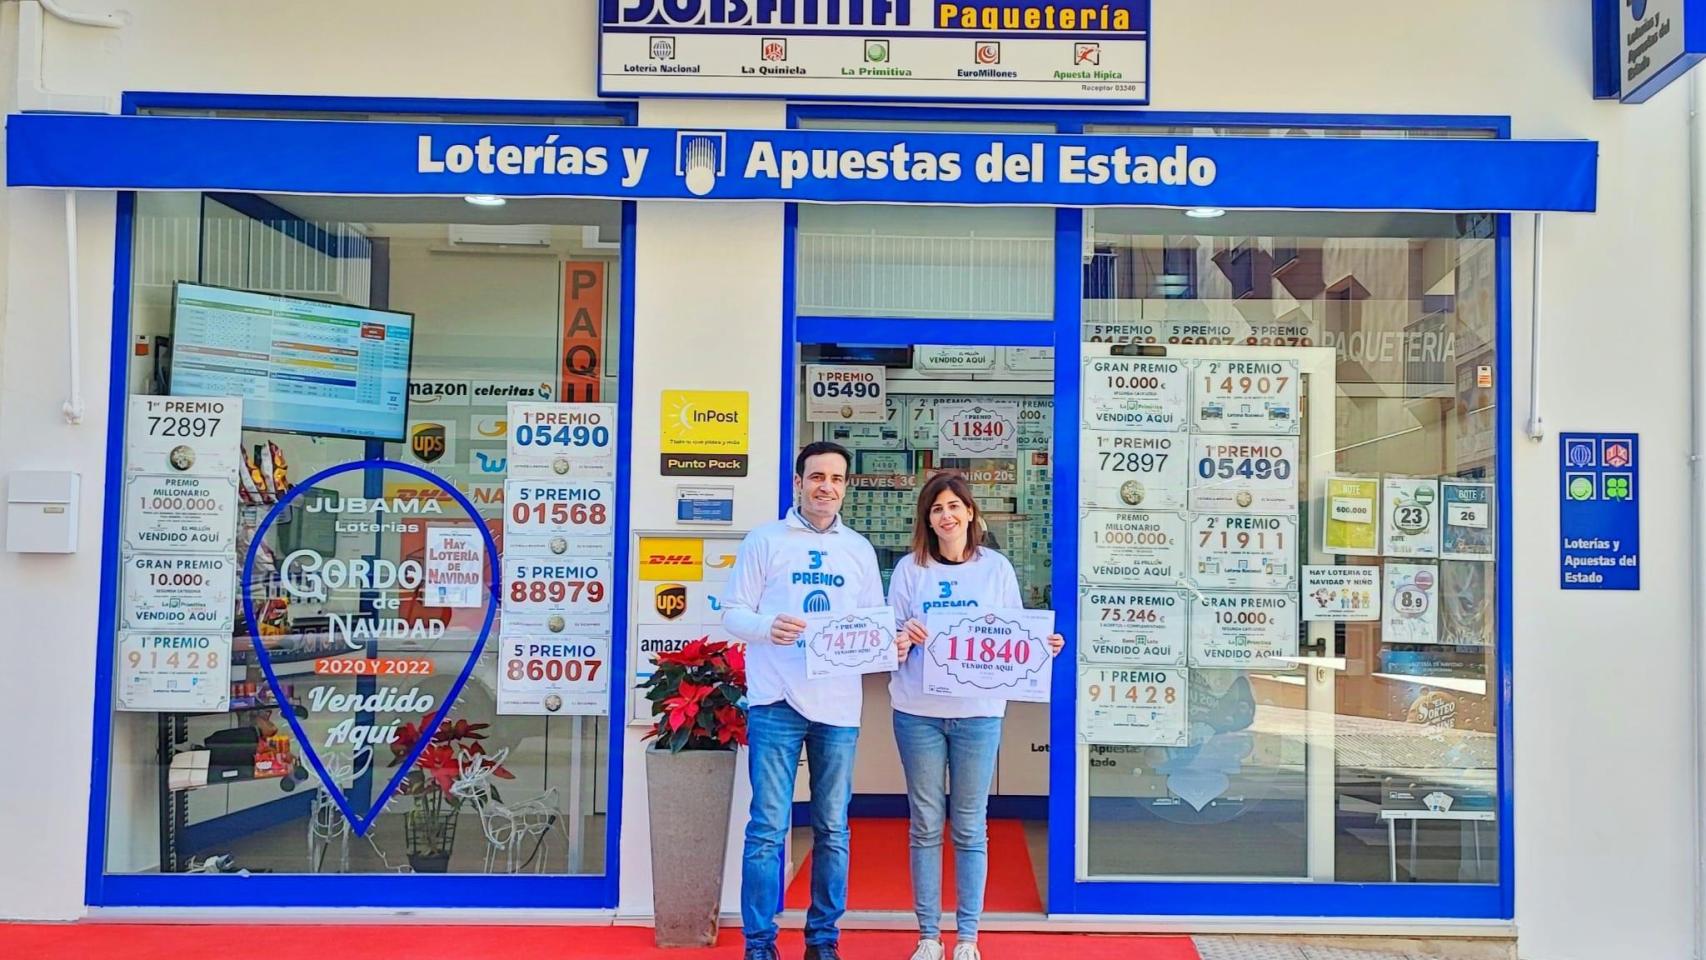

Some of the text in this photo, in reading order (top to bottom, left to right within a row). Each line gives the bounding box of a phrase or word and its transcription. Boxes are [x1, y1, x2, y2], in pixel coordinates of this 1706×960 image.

[940, 5, 1129, 29] Paquetería
[660, 65, 700, 73] Nacional
[741, 66, 806, 75] La Quiniela
[859, 69, 912, 77] Primitiva
[957, 69, 1017, 78] EuroMillones
[1054, 70, 1090, 79] Apuesta
[418, 134, 1216, 189] Loterías y Apuestas del Estado
[1106, 326, 1152, 334] PREMIO
[1184, 326, 1230, 335] PREMIO
[1262, 327, 1308, 335] PREMIO
[1322, 324, 1456, 364] PAQUETERÍA
[1095, 363, 1177, 373] GRAN PREMIO
[1229, 363, 1282, 374] PREMIO
[827, 373, 873, 382] PREMIO
[1108, 377, 1158, 389] 10.000
[409, 382, 467, 396] mazon
[475, 384, 534, 397] celeritas
[813, 382, 880, 397] 05490
[1204, 377, 1288, 393] 14907
[165, 403, 224, 413] PREMIO
[536, 413, 600, 425] PREMIO
[694, 410, 738, 422] InPost
[1096, 413, 1173, 423] VENDIDO AQUÍ
[148, 417, 221, 437] 72897
[953, 421, 1003, 436] 11840
[516, 425, 609, 447] 05490
[414, 436, 444, 457] ups
[1114, 437, 1171, 449] PREMIO
[1218, 446, 1282, 458] PREMIO
[668, 460, 741, 468] Punto Pack
[1098, 452, 1168, 472] 72897
[1199, 458, 1290, 479] 05490
[535, 489, 600, 501] PREMIO
[1458, 490, 1476, 499] BOTE
[141, 497, 216, 510] 1.000.000
[306, 497, 442, 513] JUBAMA
[513, 503, 606, 524] 01568
[1401, 508, 1422, 524] 23
[1461, 512, 1475, 520] 26
[336, 521, 419, 533] Loterias
[1106, 523, 1160, 531] MILLONARIO
[1227, 518, 1280, 529] PREMIO
[139, 532, 219, 542] VENDIDO AQUÍ
[1094, 531, 1167, 545] 1.000.000
[1200, 531, 1282, 549] 71911
[1565, 538, 1619, 551] Loterías y
[136, 559, 223, 569] GRAN PREMIO
[650, 556, 693, 565] DHL
[1565, 555, 1636, 568] Apuestas del
[448, 563, 460, 571] DE
[533, 567, 598, 579] PREMIO
[1093, 566, 1171, 577] VENDIDO AQUÍ
[150, 573, 202, 586] 10.000
[280, 550, 422, 603] GORDO
[792, 573, 845, 587] PREMIO
[1565, 572, 1602, 583] Estado
[511, 581, 604, 603] 88979
[373, 591, 400, 610] de
[657, 596, 684, 615] ups
[1091, 595, 1174, 606] GRAN PREMIO
[1202, 598, 1286, 608] GRAN PREMIO
[136, 610, 216, 621] VENDIDO AQUÍ
[1101, 609, 1156, 623] 75.246
[1216, 612, 1266, 624] 10.000
[325, 613, 445, 649] NAVIDAD
[975, 626, 1011, 635] PREMIO
[154, 637, 209, 648] PREMIO
[823, 630, 880, 651] 74778
[530, 645, 595, 657] PREMIO
[947, 636, 1029, 664] 11840
[1093, 644, 1170, 655] VENDIDO AQUÍ
[1204, 649, 1251, 659] VENDIDO
[128, 651, 218, 669] 91428
[320, 660, 430, 674] 2020 Y 2022
[507, 660, 602, 681] 86007
[1112, 671, 1166, 684] PREMIO
[308, 686, 434, 713] Vendido
[1089, 685, 1176, 704] 91428
[325, 718, 401, 749] Aquí
